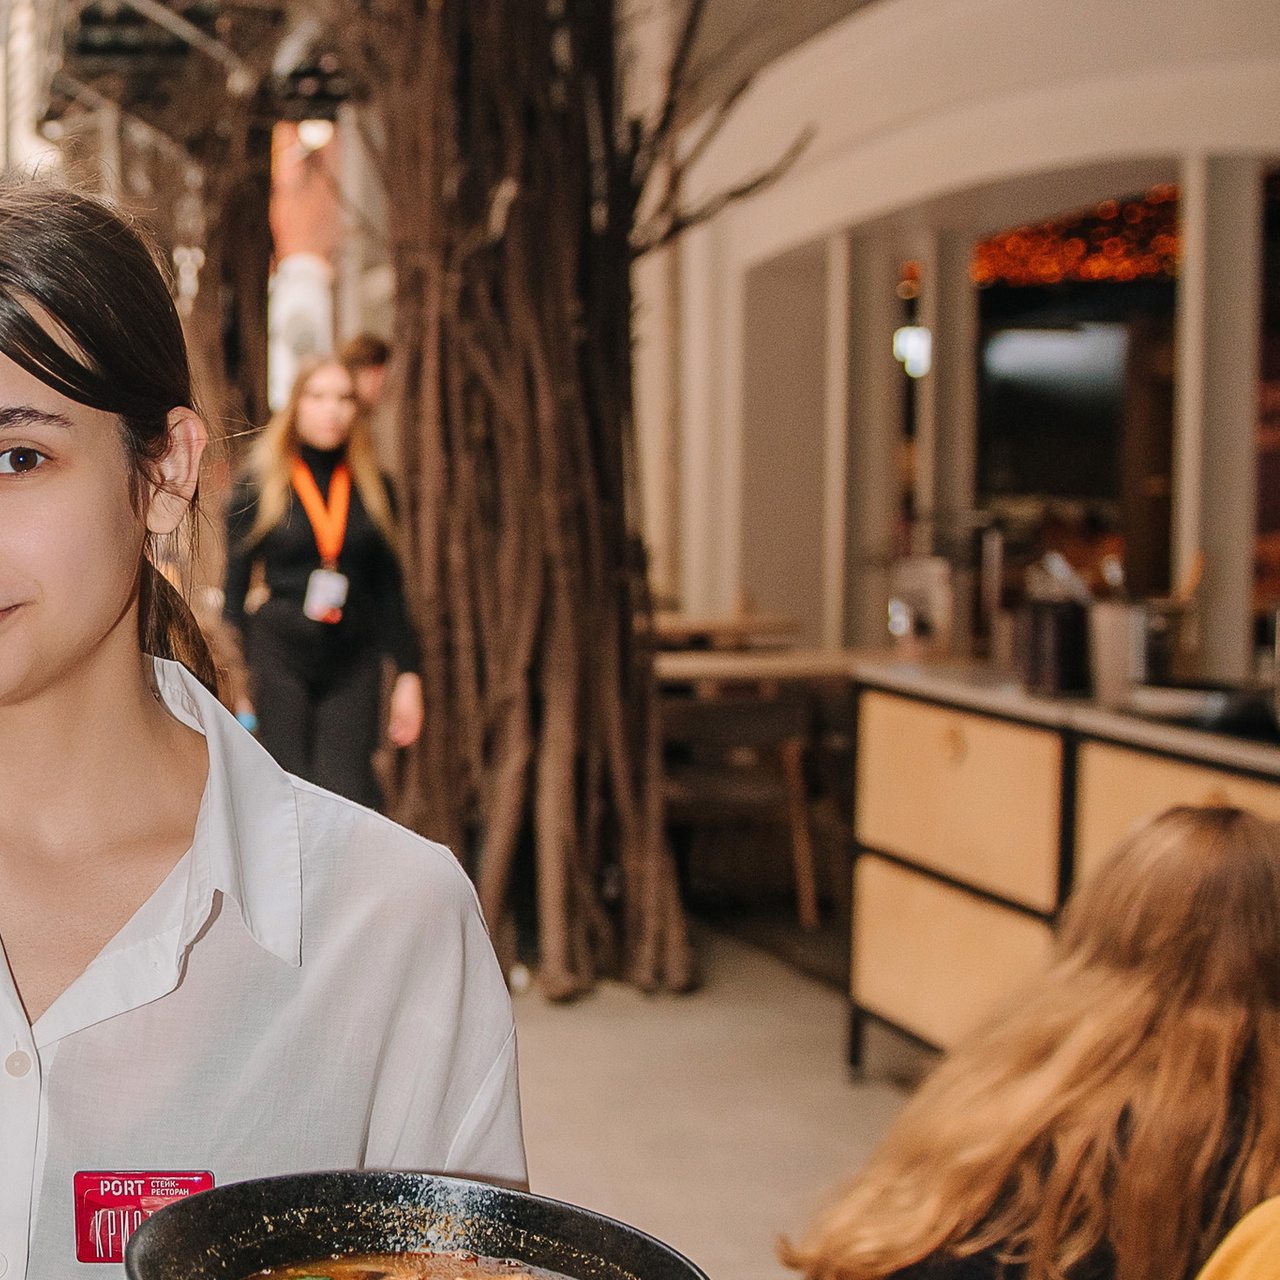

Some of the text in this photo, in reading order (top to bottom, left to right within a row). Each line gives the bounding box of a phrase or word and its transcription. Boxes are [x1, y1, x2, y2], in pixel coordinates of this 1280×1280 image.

[100, 1179, 145, 1196] PORT
[151, 1188, 189, 1196] РЕСТОРАН
[94, 1210, 154, 1258] КРИ
